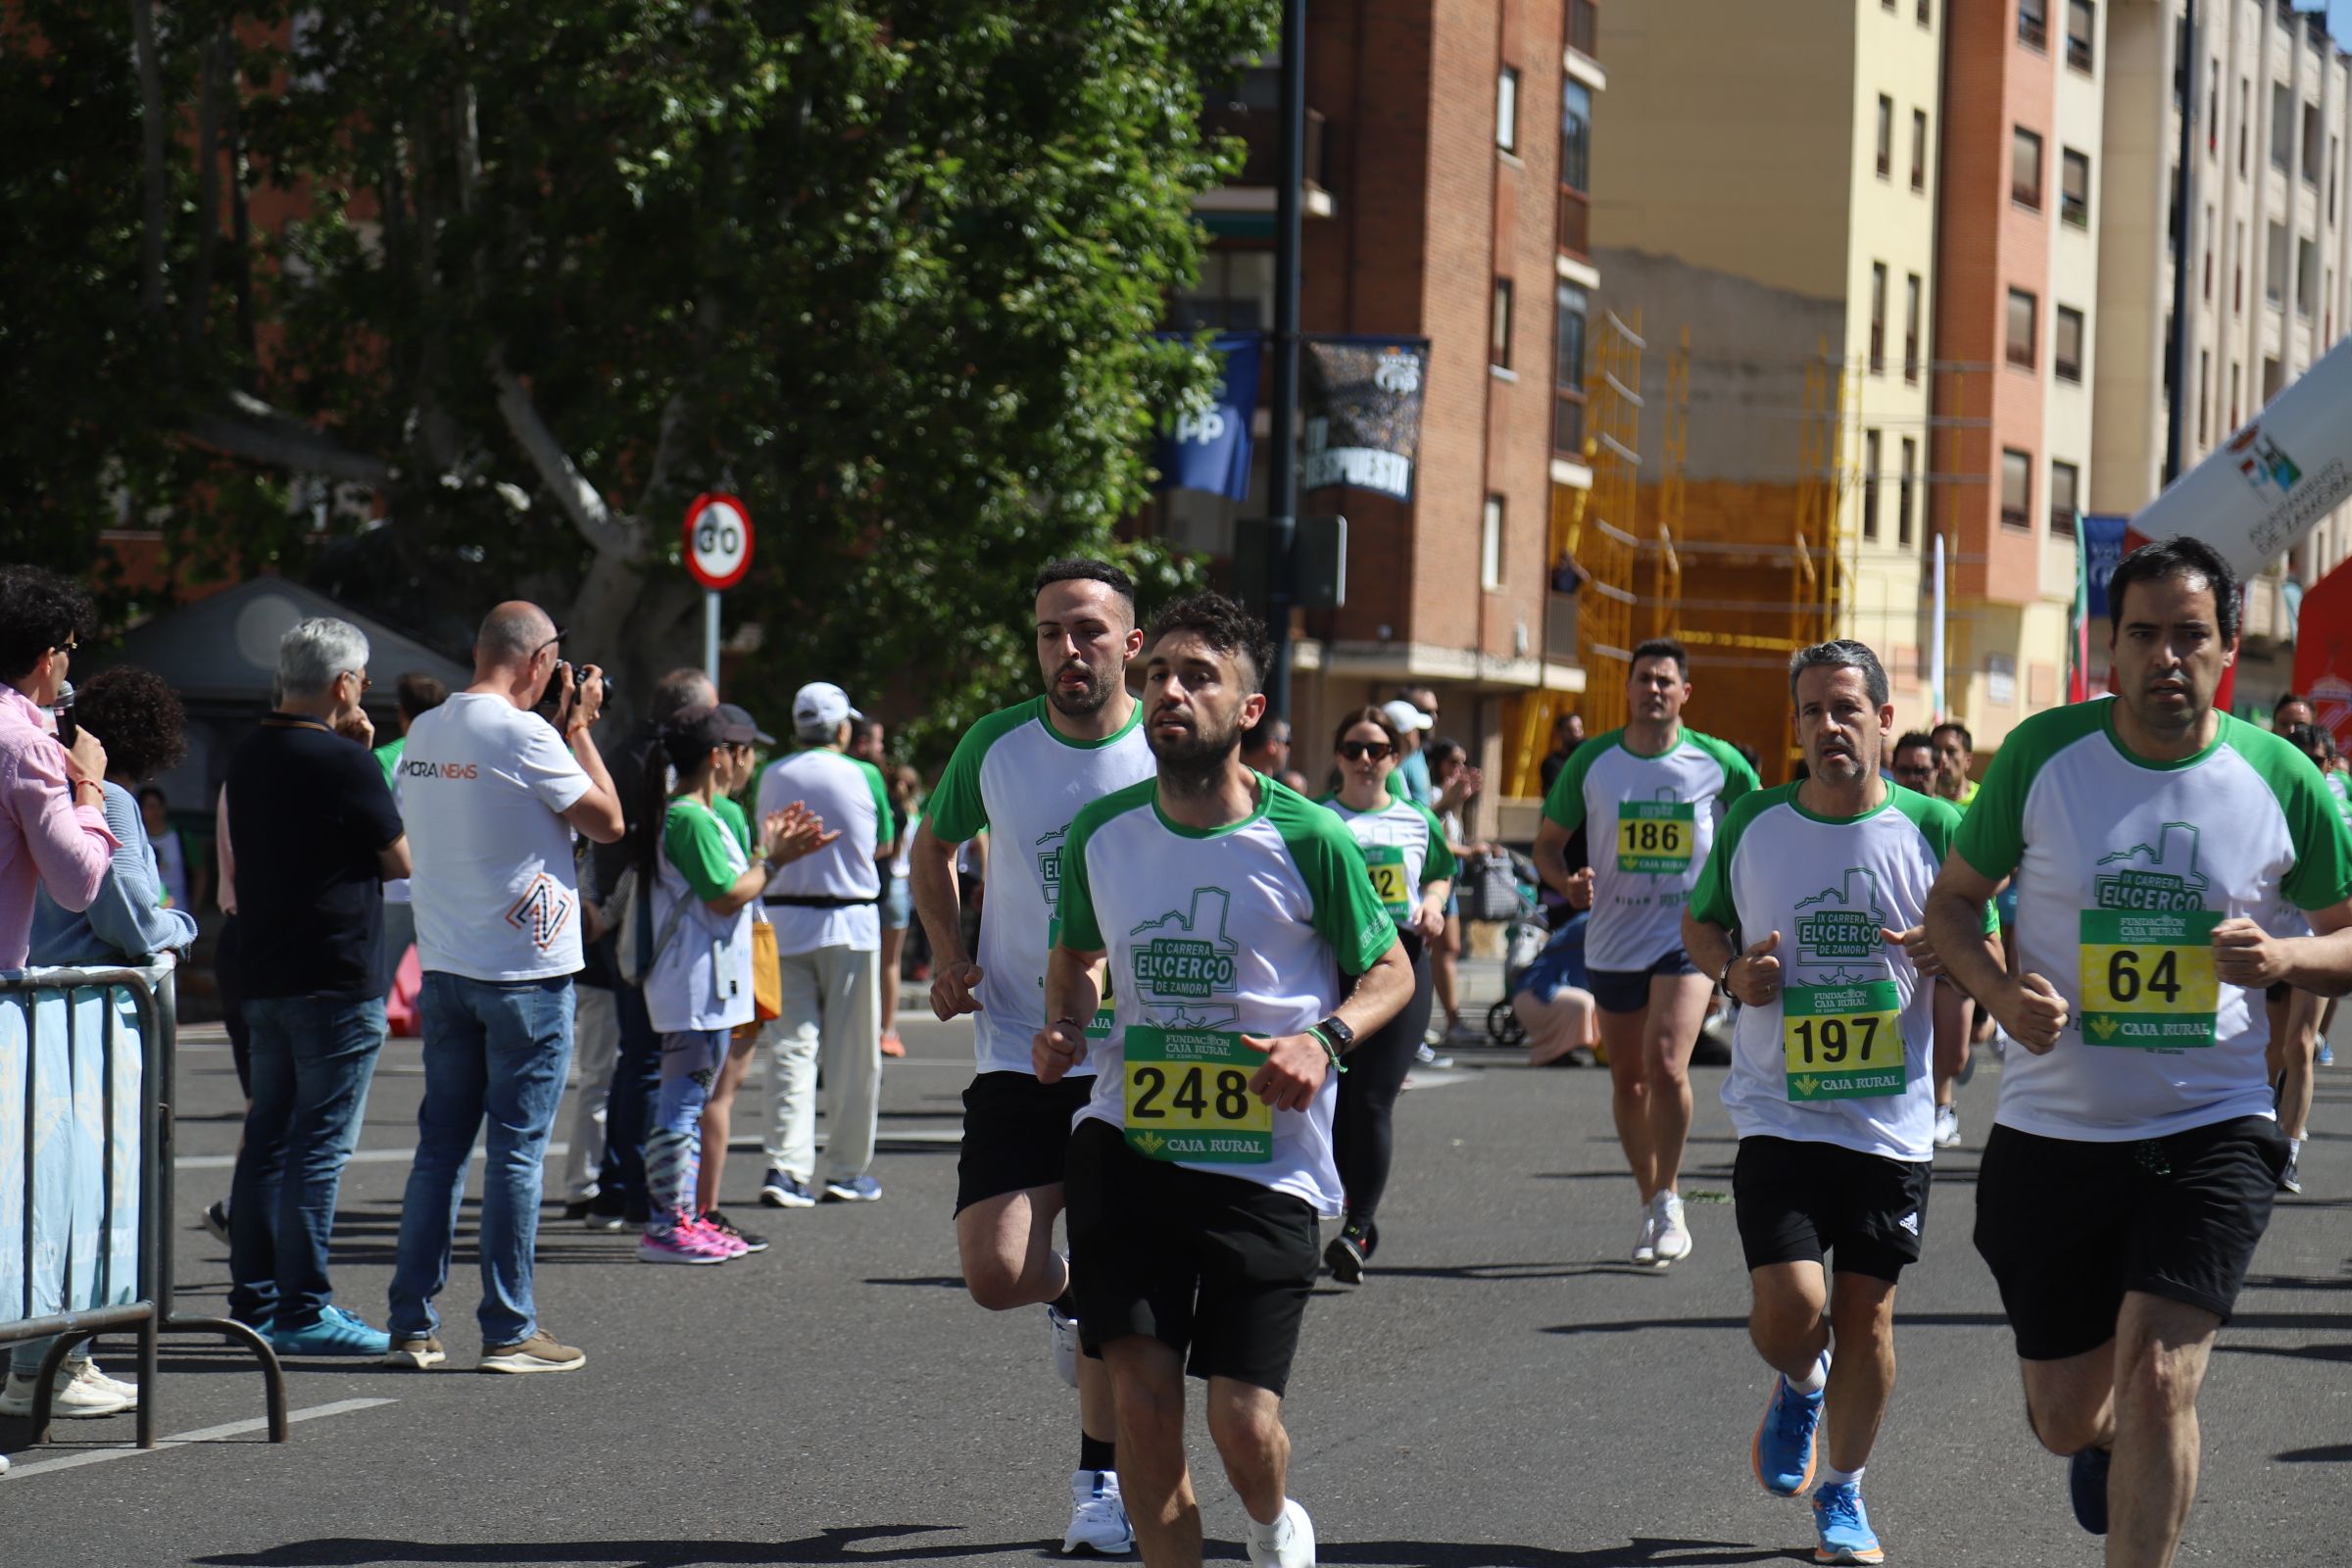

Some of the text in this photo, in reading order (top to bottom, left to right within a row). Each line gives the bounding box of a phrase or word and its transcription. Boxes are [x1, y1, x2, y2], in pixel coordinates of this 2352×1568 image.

[699, 524, 739, 555] 30
[439, 763, 477, 779] NEWS
[1625, 821, 1679, 851] 186
[2134, 875, 2180, 890] CARRERA
[2102, 885, 2201, 910] EL CERCO
[1828, 913, 1865, 924] CARRERA
[1802, 924, 1881, 944] EL CERCO
[2121, 926, 2187, 937] CAJA RURAL
[1154, 942, 1211, 957] IX CARRERA
[1819, 944, 1867, 955] DE ZAMORA
[1137, 955, 1230, 980] EL CERCO
[2109, 950, 2181, 1004] 64
[1156, 980, 1209, 996] DE ZAMORA
[1814, 998, 1868, 1008] CAJA RURAL
[2121, 1022, 2211, 1037] CAJA RURAL
[1793, 1017, 1880, 1064] 197
[1165, 1043, 1231, 1056] CAJA RURAL
[1821, 1075, 1900, 1091] CAJA RURAL
[1133, 1066, 1249, 1120] 248
[1167, 1139, 1264, 1153] CAJA RURAL
